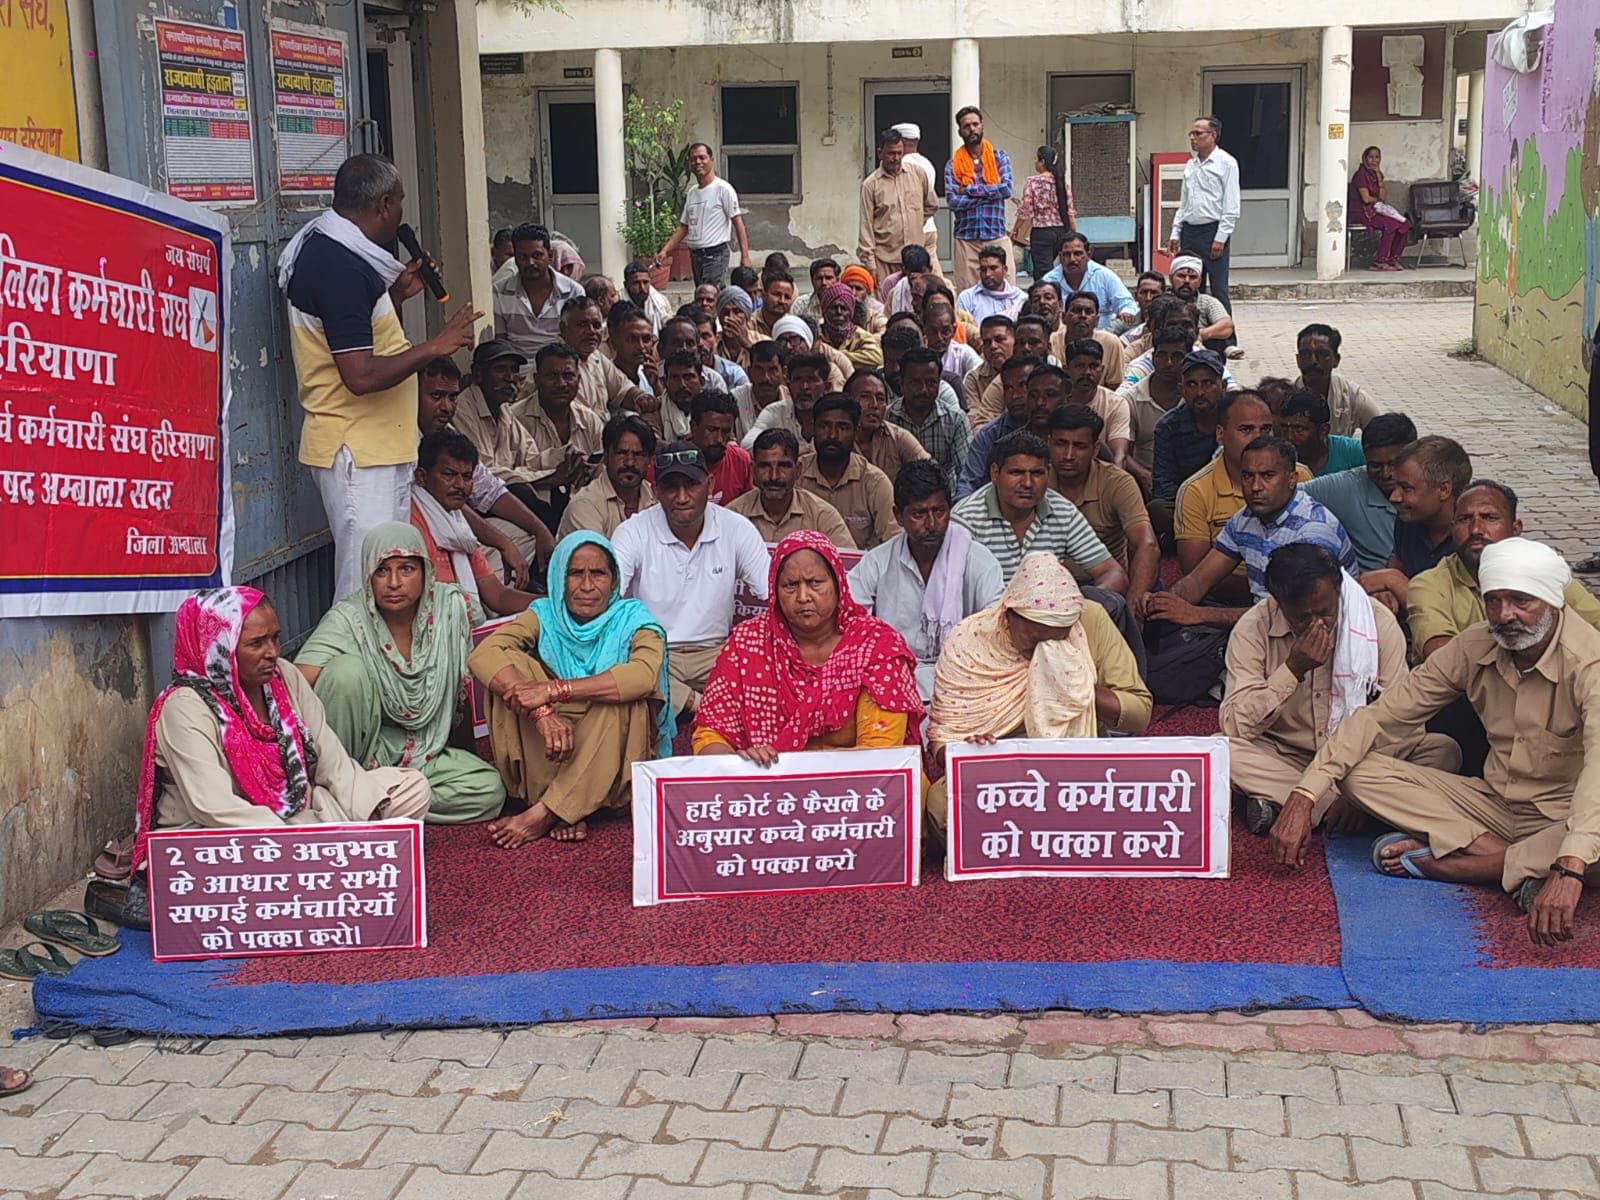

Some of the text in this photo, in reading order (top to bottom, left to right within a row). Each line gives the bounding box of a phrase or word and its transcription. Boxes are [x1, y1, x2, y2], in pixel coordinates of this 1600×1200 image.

[165, 244, 184, 267] जय
[67, 256, 154, 334] कर्मचारी
[158, 274, 188, 341] संघ
[0, 321, 118, 386] रियाणा
[18, 405, 106, 451] कर्मचारी
[110, 414, 147, 455] संघ
[151, 418, 216, 463] हरियाणा
[0, 470, 174, 511] षद अम्बाला सदर
[126, 526, 208, 555] जिला अम्बाला
[686, 788, 886, 822] हाई कोर्ट के फैसले के
[976, 768, 1196, 813] कच्चे कर्मचारी
[675, 815, 896, 853] अनुसार कच्चे कर्मचारी
[981, 820, 1185, 859] को पक्का करो
[166, 838, 398, 867] 2 वर्ष के अनुभव
[716, 849, 856, 876] को पक्का करो
[169, 864, 401, 895] के आधार पर सभी
[168, 892, 397, 924] सफाई कर्मचारियों
[201, 926, 233, 950] को
[240, 928, 303, 949] पक्का
